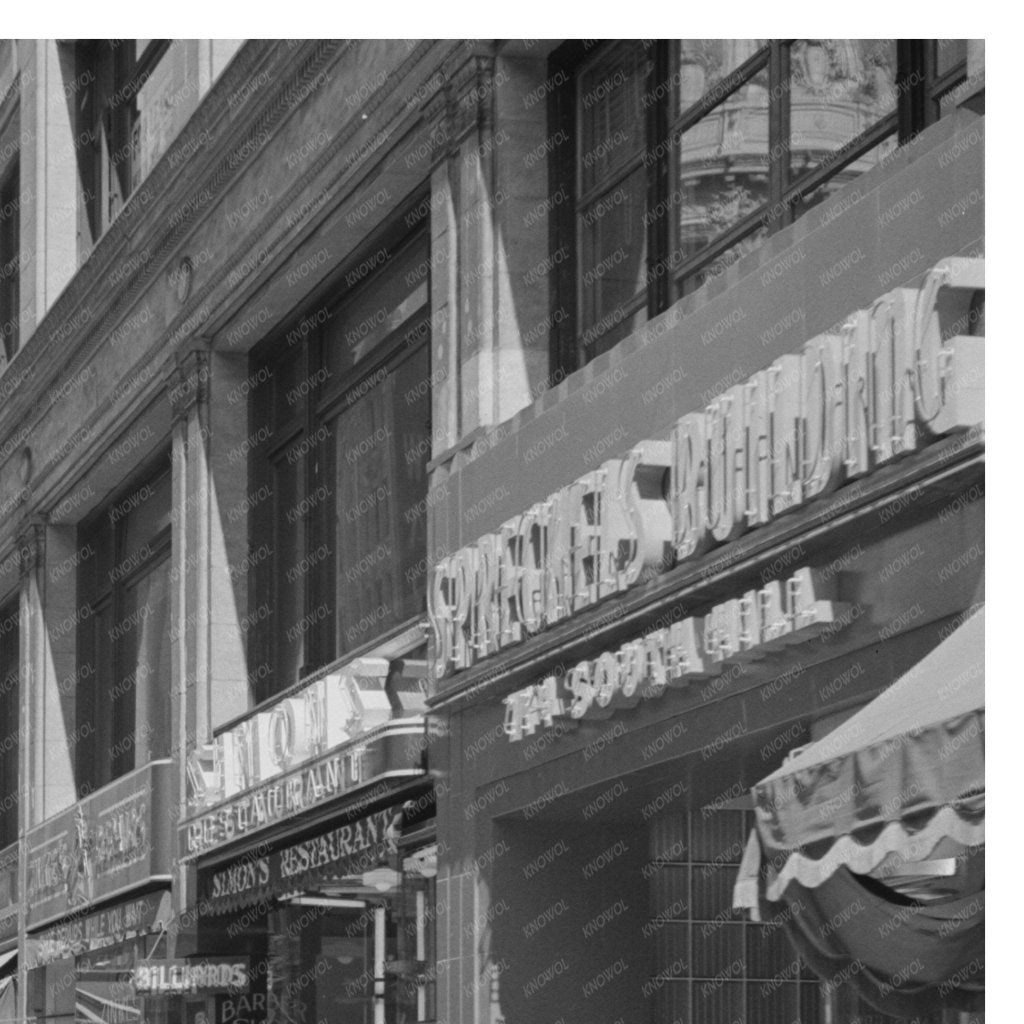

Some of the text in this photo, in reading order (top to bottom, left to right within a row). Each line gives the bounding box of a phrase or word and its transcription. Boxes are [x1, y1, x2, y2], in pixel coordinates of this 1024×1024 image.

[212, 808, 394, 898] SIMON'S RESTAURANT
[135, 963, 247, 990] BILLIARDS
